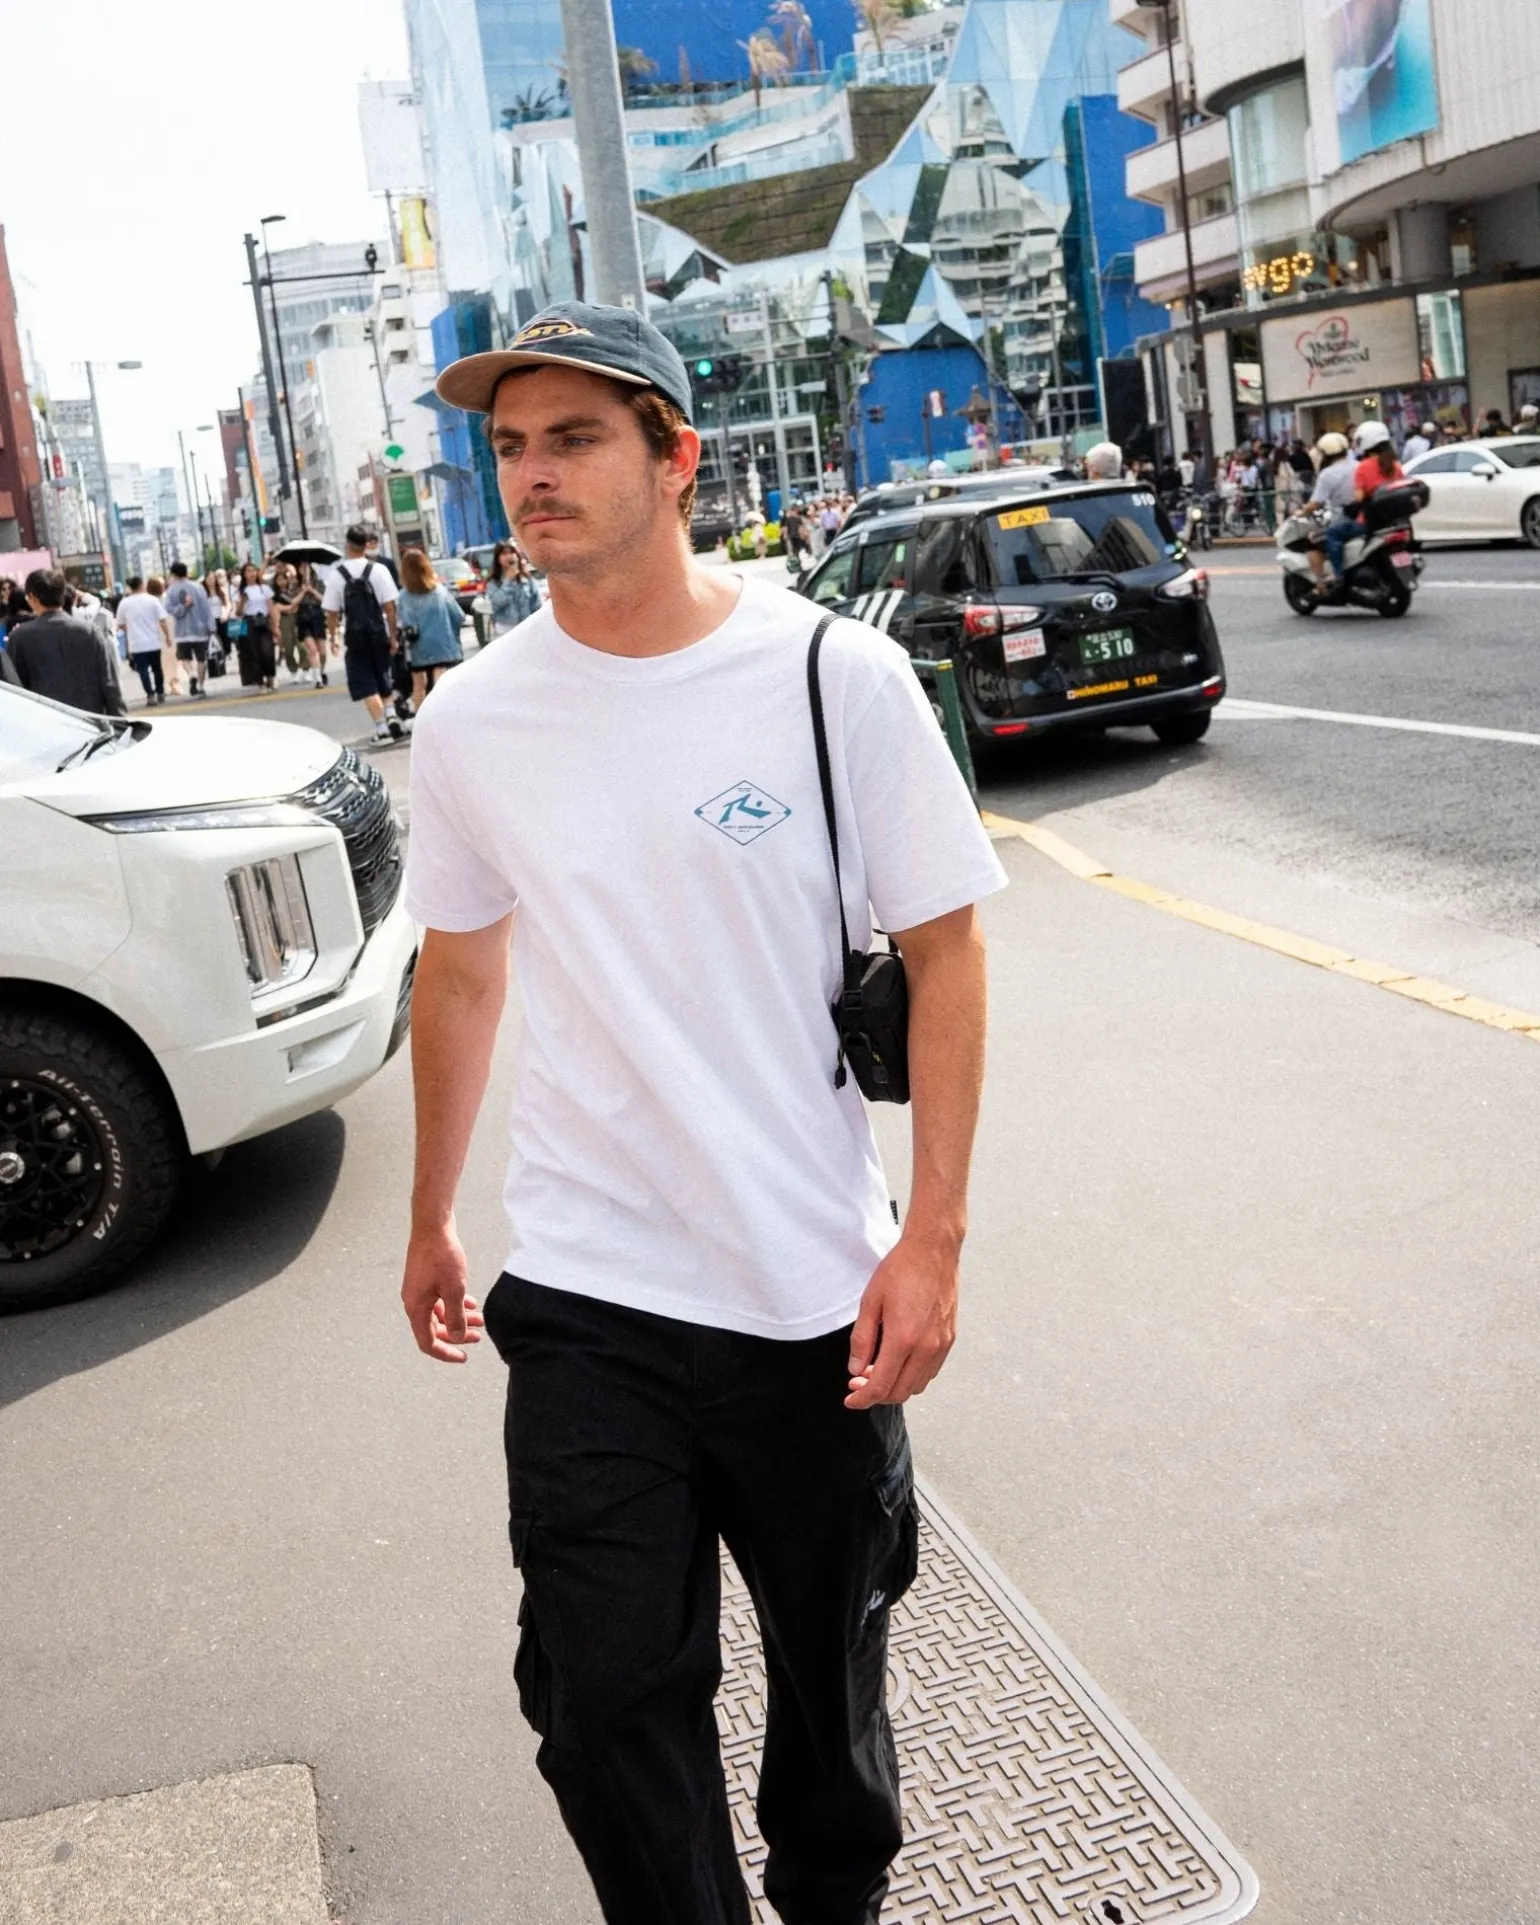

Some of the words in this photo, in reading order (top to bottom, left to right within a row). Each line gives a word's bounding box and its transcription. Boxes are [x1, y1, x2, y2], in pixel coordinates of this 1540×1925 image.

[1131, 493, 1156, 506] 510
[1002, 508, 1047, 526] TAXI
[1133, 673, 1158, 687] TAXI
